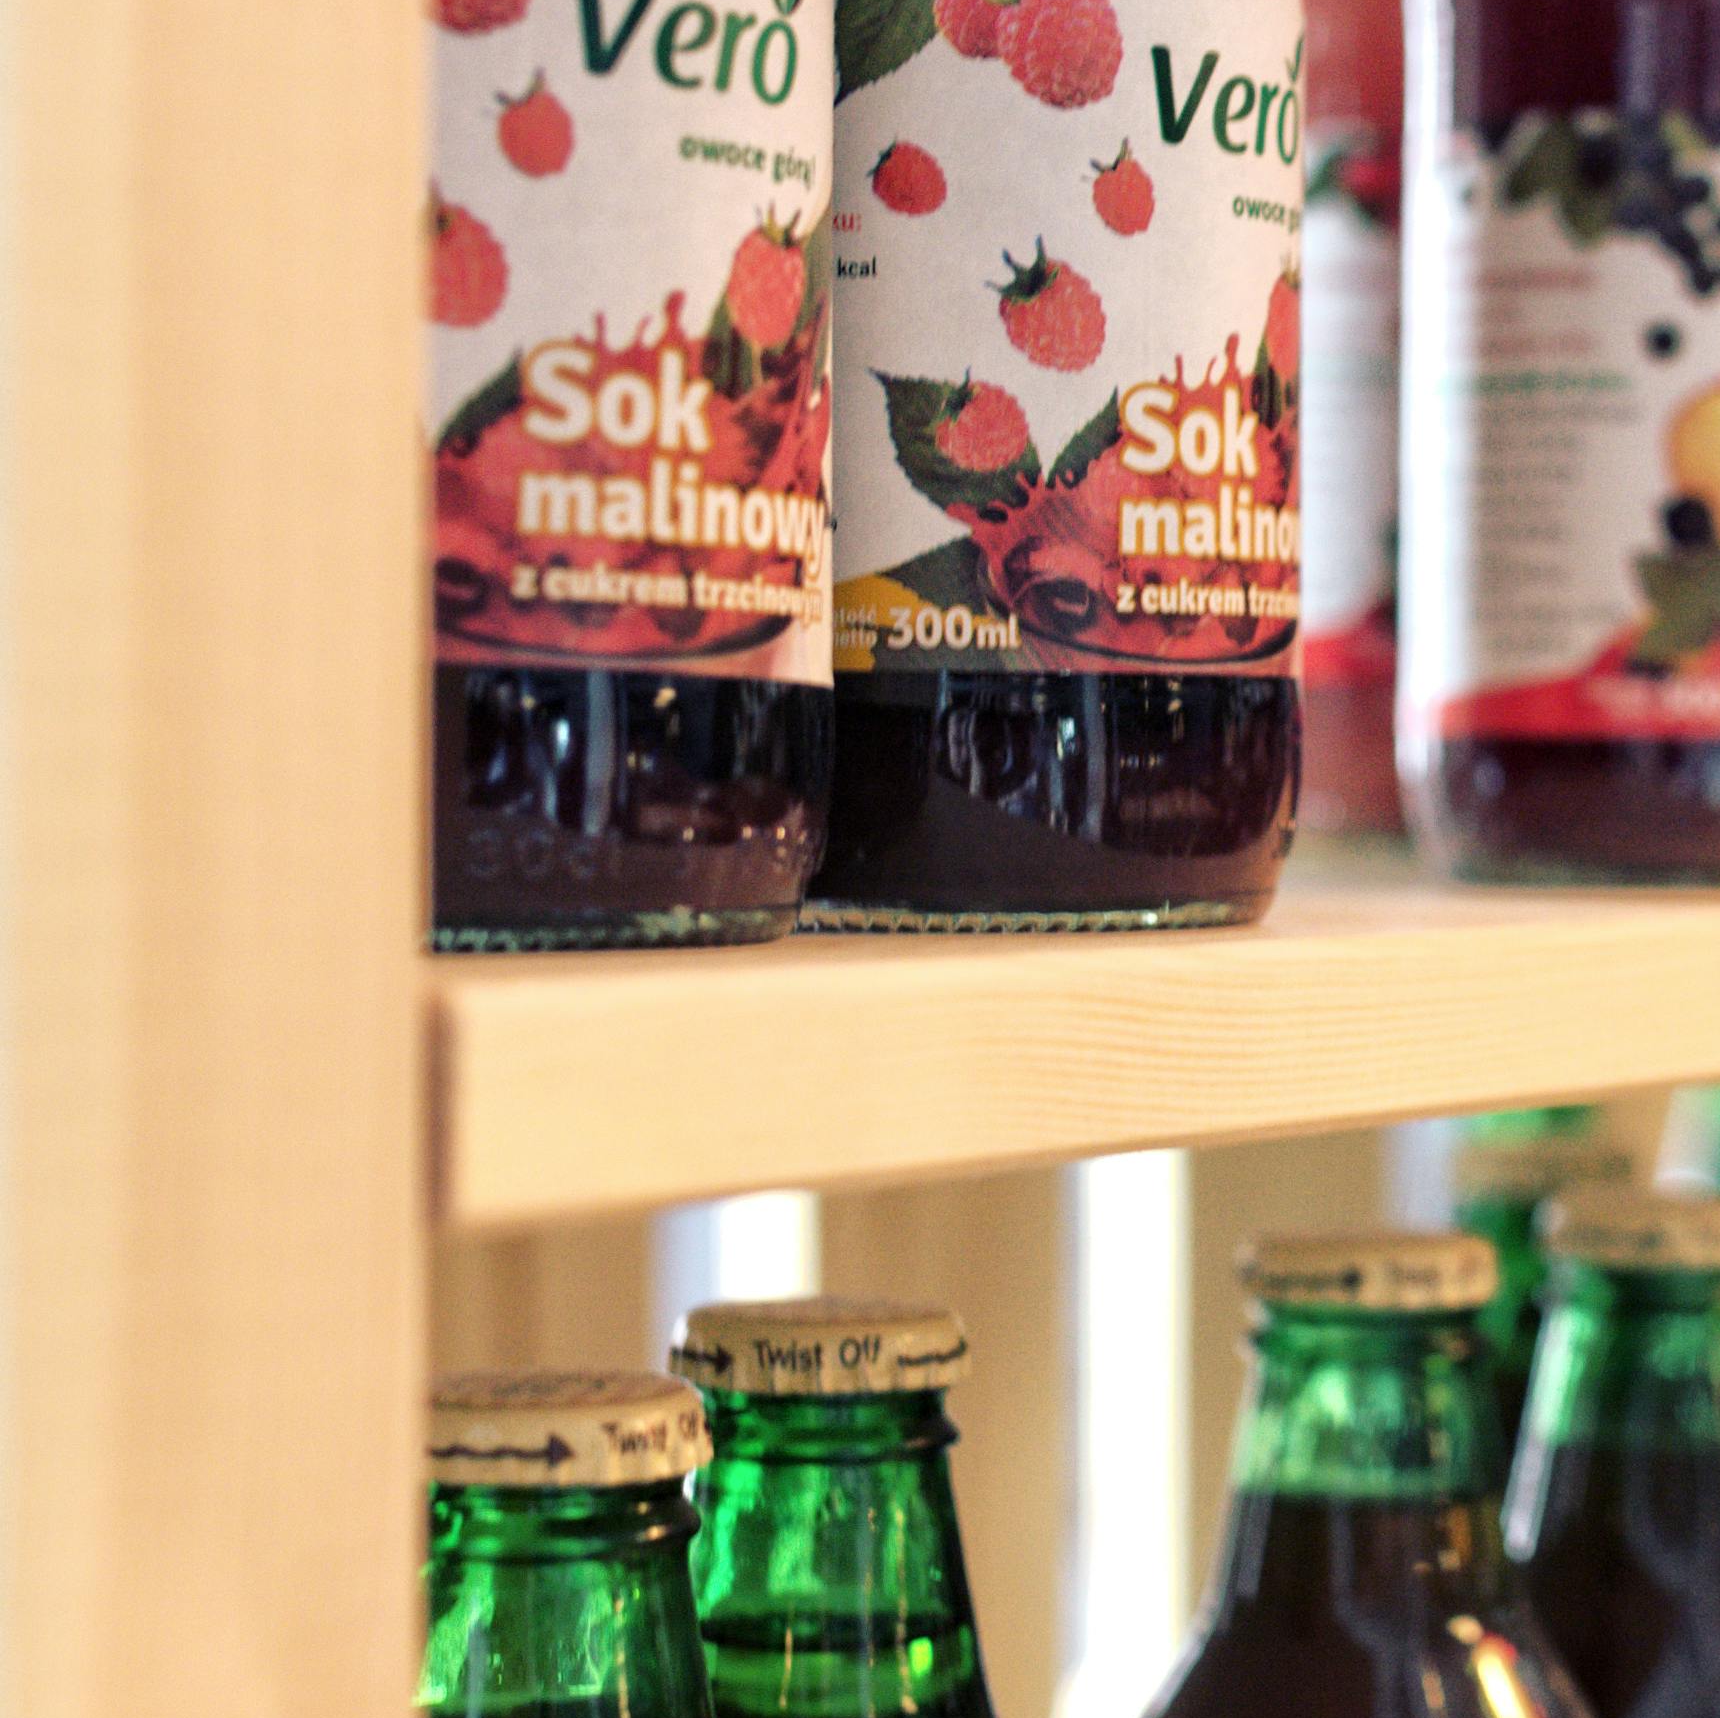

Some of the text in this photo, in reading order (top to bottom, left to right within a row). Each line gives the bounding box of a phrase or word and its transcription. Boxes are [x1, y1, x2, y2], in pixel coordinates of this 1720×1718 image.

[678, 135, 766, 172] owoce
[836, 255, 878, 279] kcal
[523, 339, 714, 453] Sok
[1120, 381, 1260, 478] Sok
[517, 456, 826, 577] malinowy
[1119, 480, 1300, 567] malino
[510, 562, 539, 600] z
[541, 560, 690, 608] cukrem
[1115, 583, 1137, 614] z
[1141, 576, 1248, 616] cukrem
[752, 1334, 882, 1370] Twist Off
